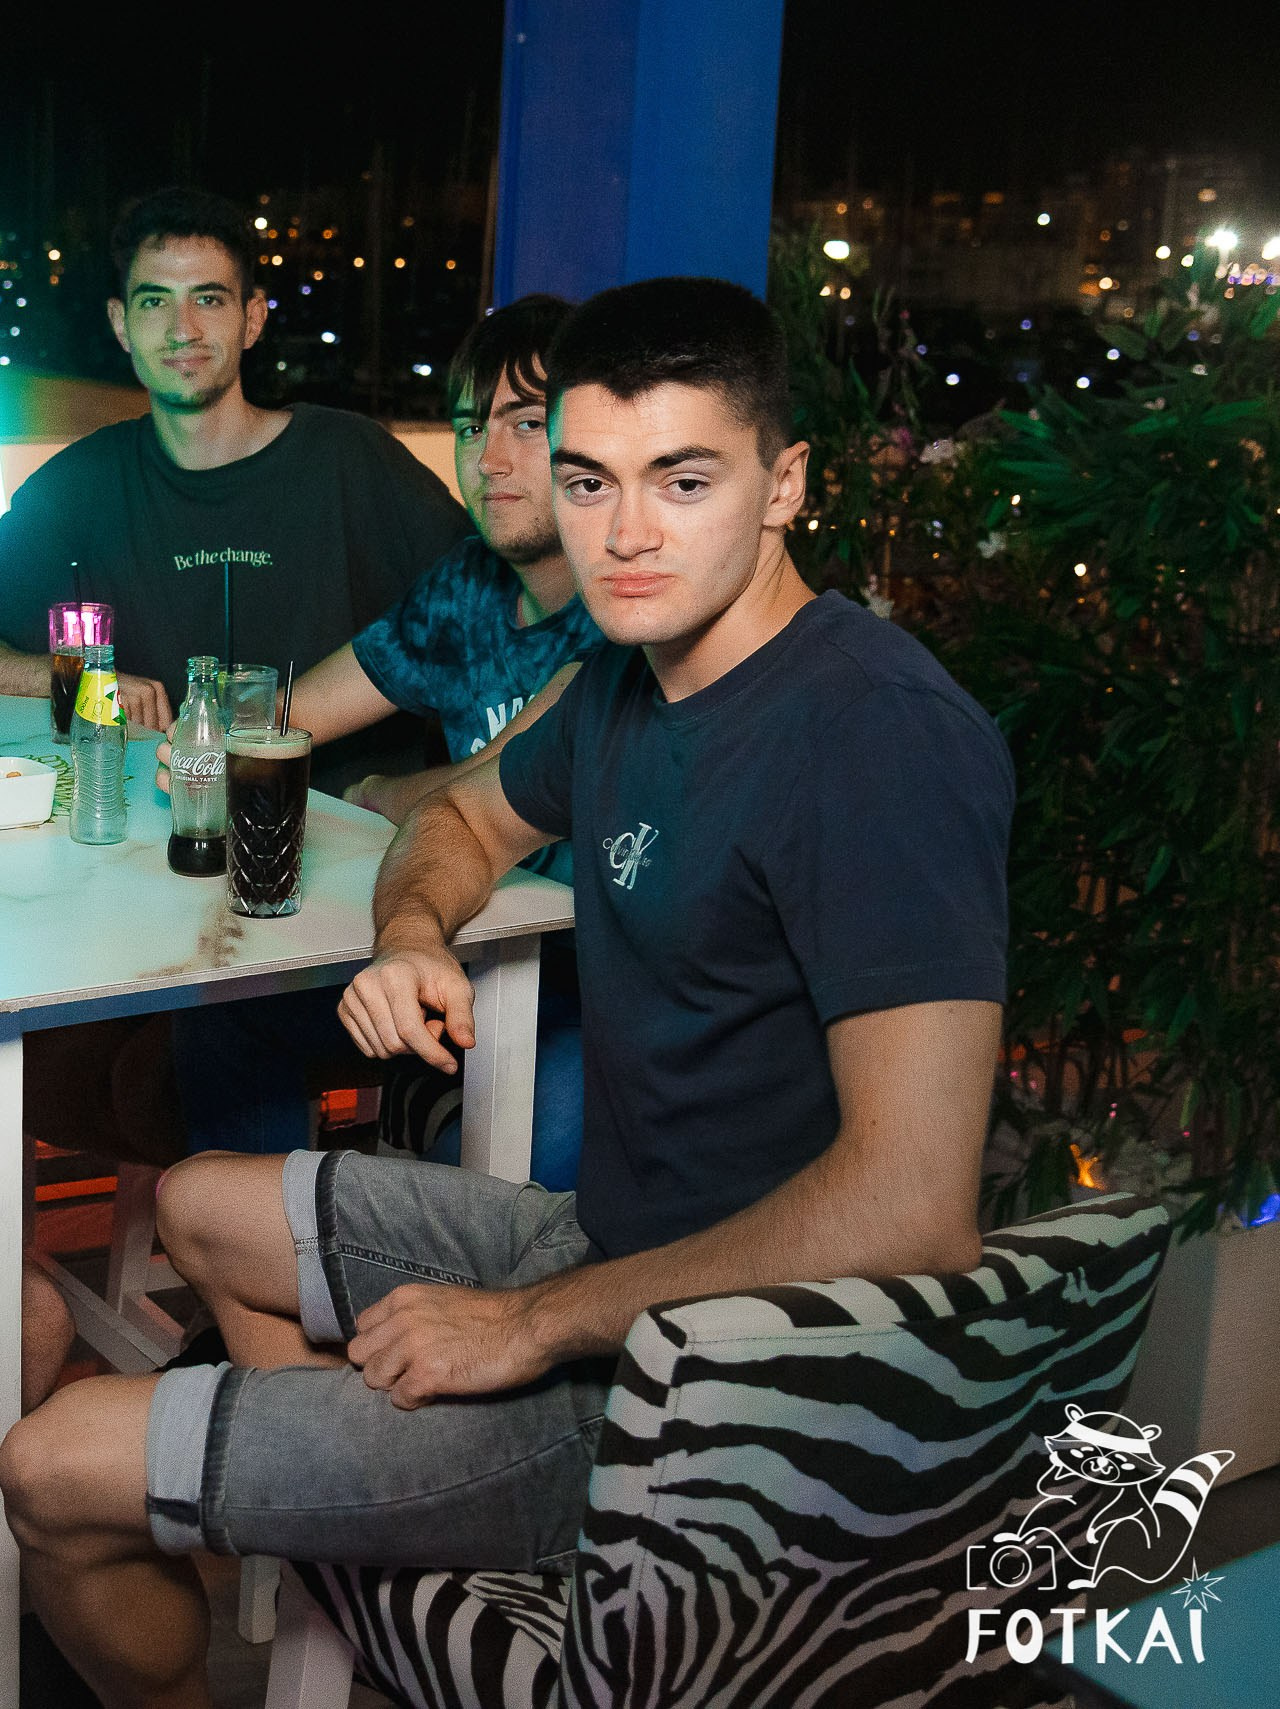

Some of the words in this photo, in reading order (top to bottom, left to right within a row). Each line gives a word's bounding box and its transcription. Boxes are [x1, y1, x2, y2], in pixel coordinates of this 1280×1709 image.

[174, 556, 194, 571] Be
[195, 549, 218, 566] the
[220, 547, 273, 568] change.
